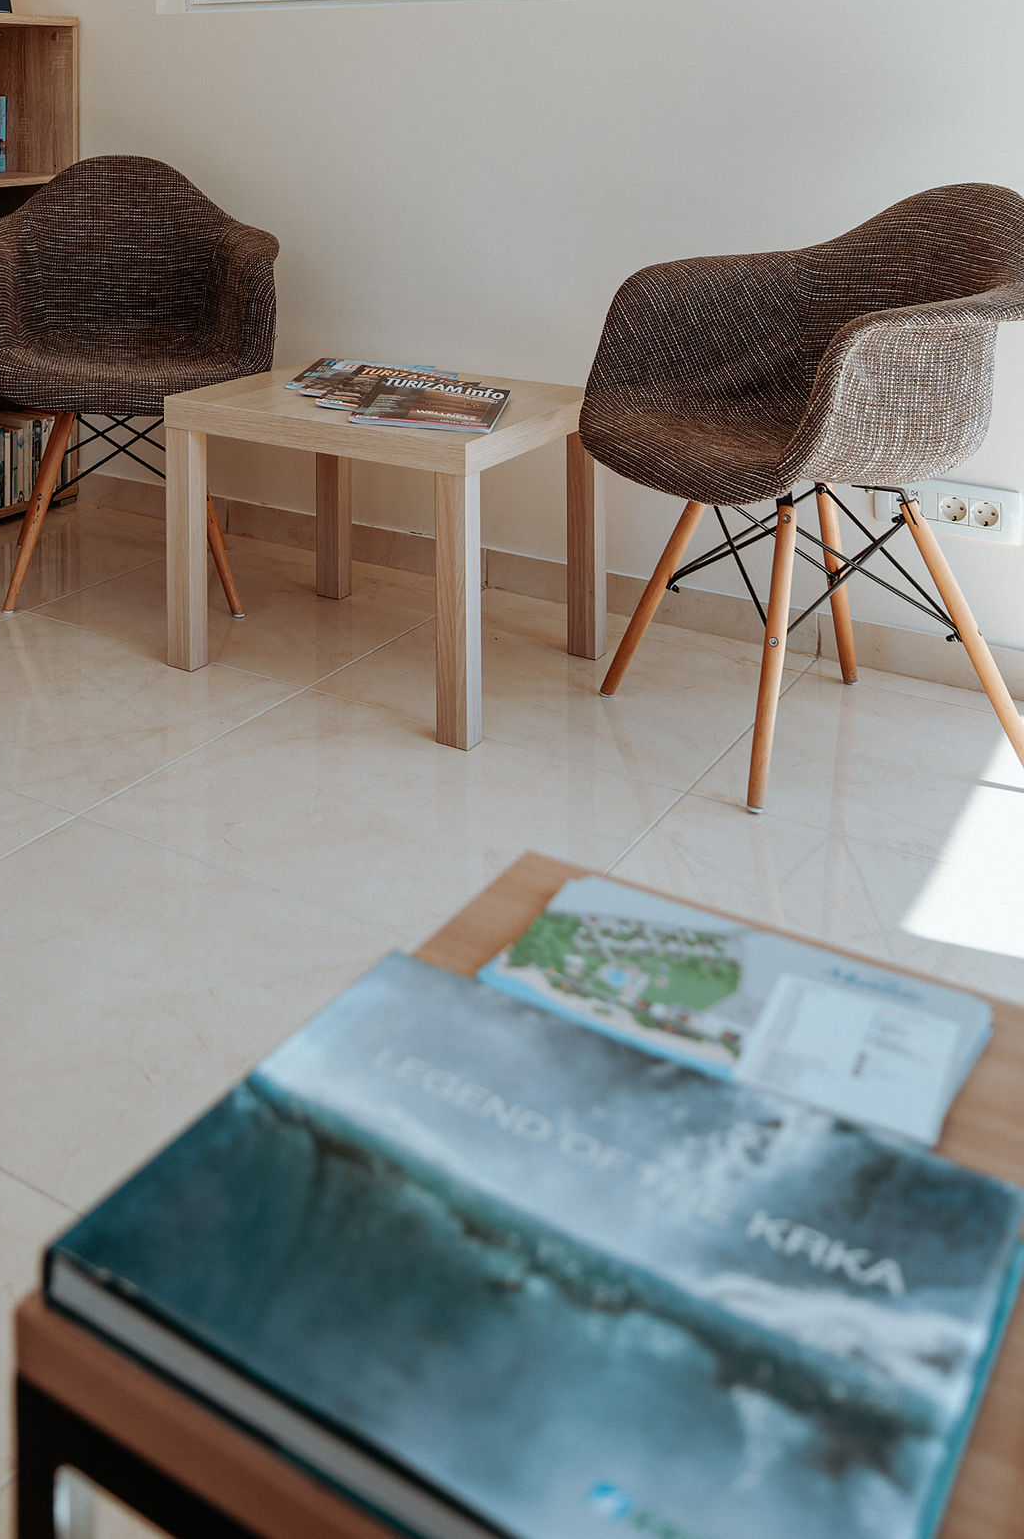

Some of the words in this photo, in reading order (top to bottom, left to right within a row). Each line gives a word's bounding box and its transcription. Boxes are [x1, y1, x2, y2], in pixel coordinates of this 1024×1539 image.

[385, 377, 463, 394] TURIZAM
[465, 388, 505, 400] info
[375, 1046, 553, 1145] LEGEND
[557, 1129, 634, 1170] OF
[746, 1209, 906, 1299] KRKA
